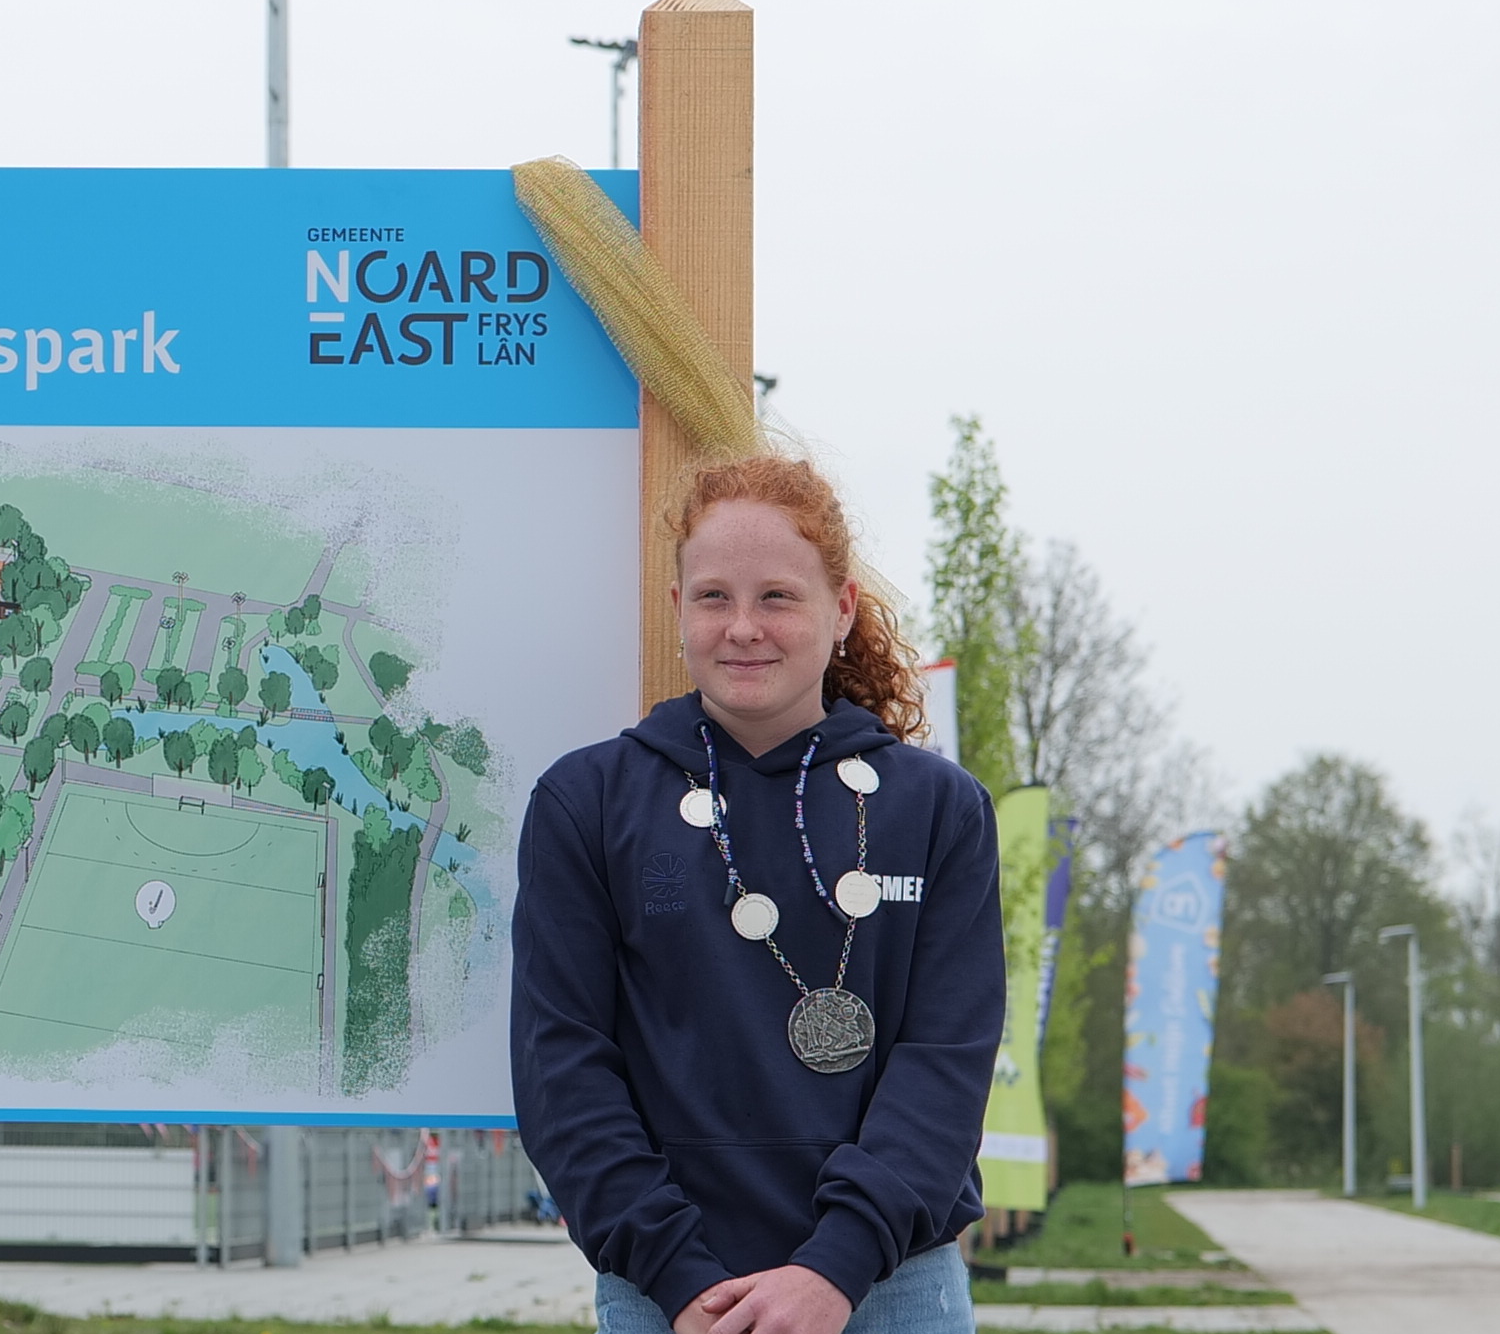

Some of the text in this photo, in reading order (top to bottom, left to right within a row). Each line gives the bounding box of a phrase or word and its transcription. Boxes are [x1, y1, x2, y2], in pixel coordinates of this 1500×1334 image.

[307, 227, 405, 242] GEMEENTE
[306, 249, 550, 303] NOARD
[478, 313, 548, 336] FRYS
[308, 312, 469, 366] EAST
[478, 338, 536, 366] LÂN
[645, 900, 686, 915] Reece
